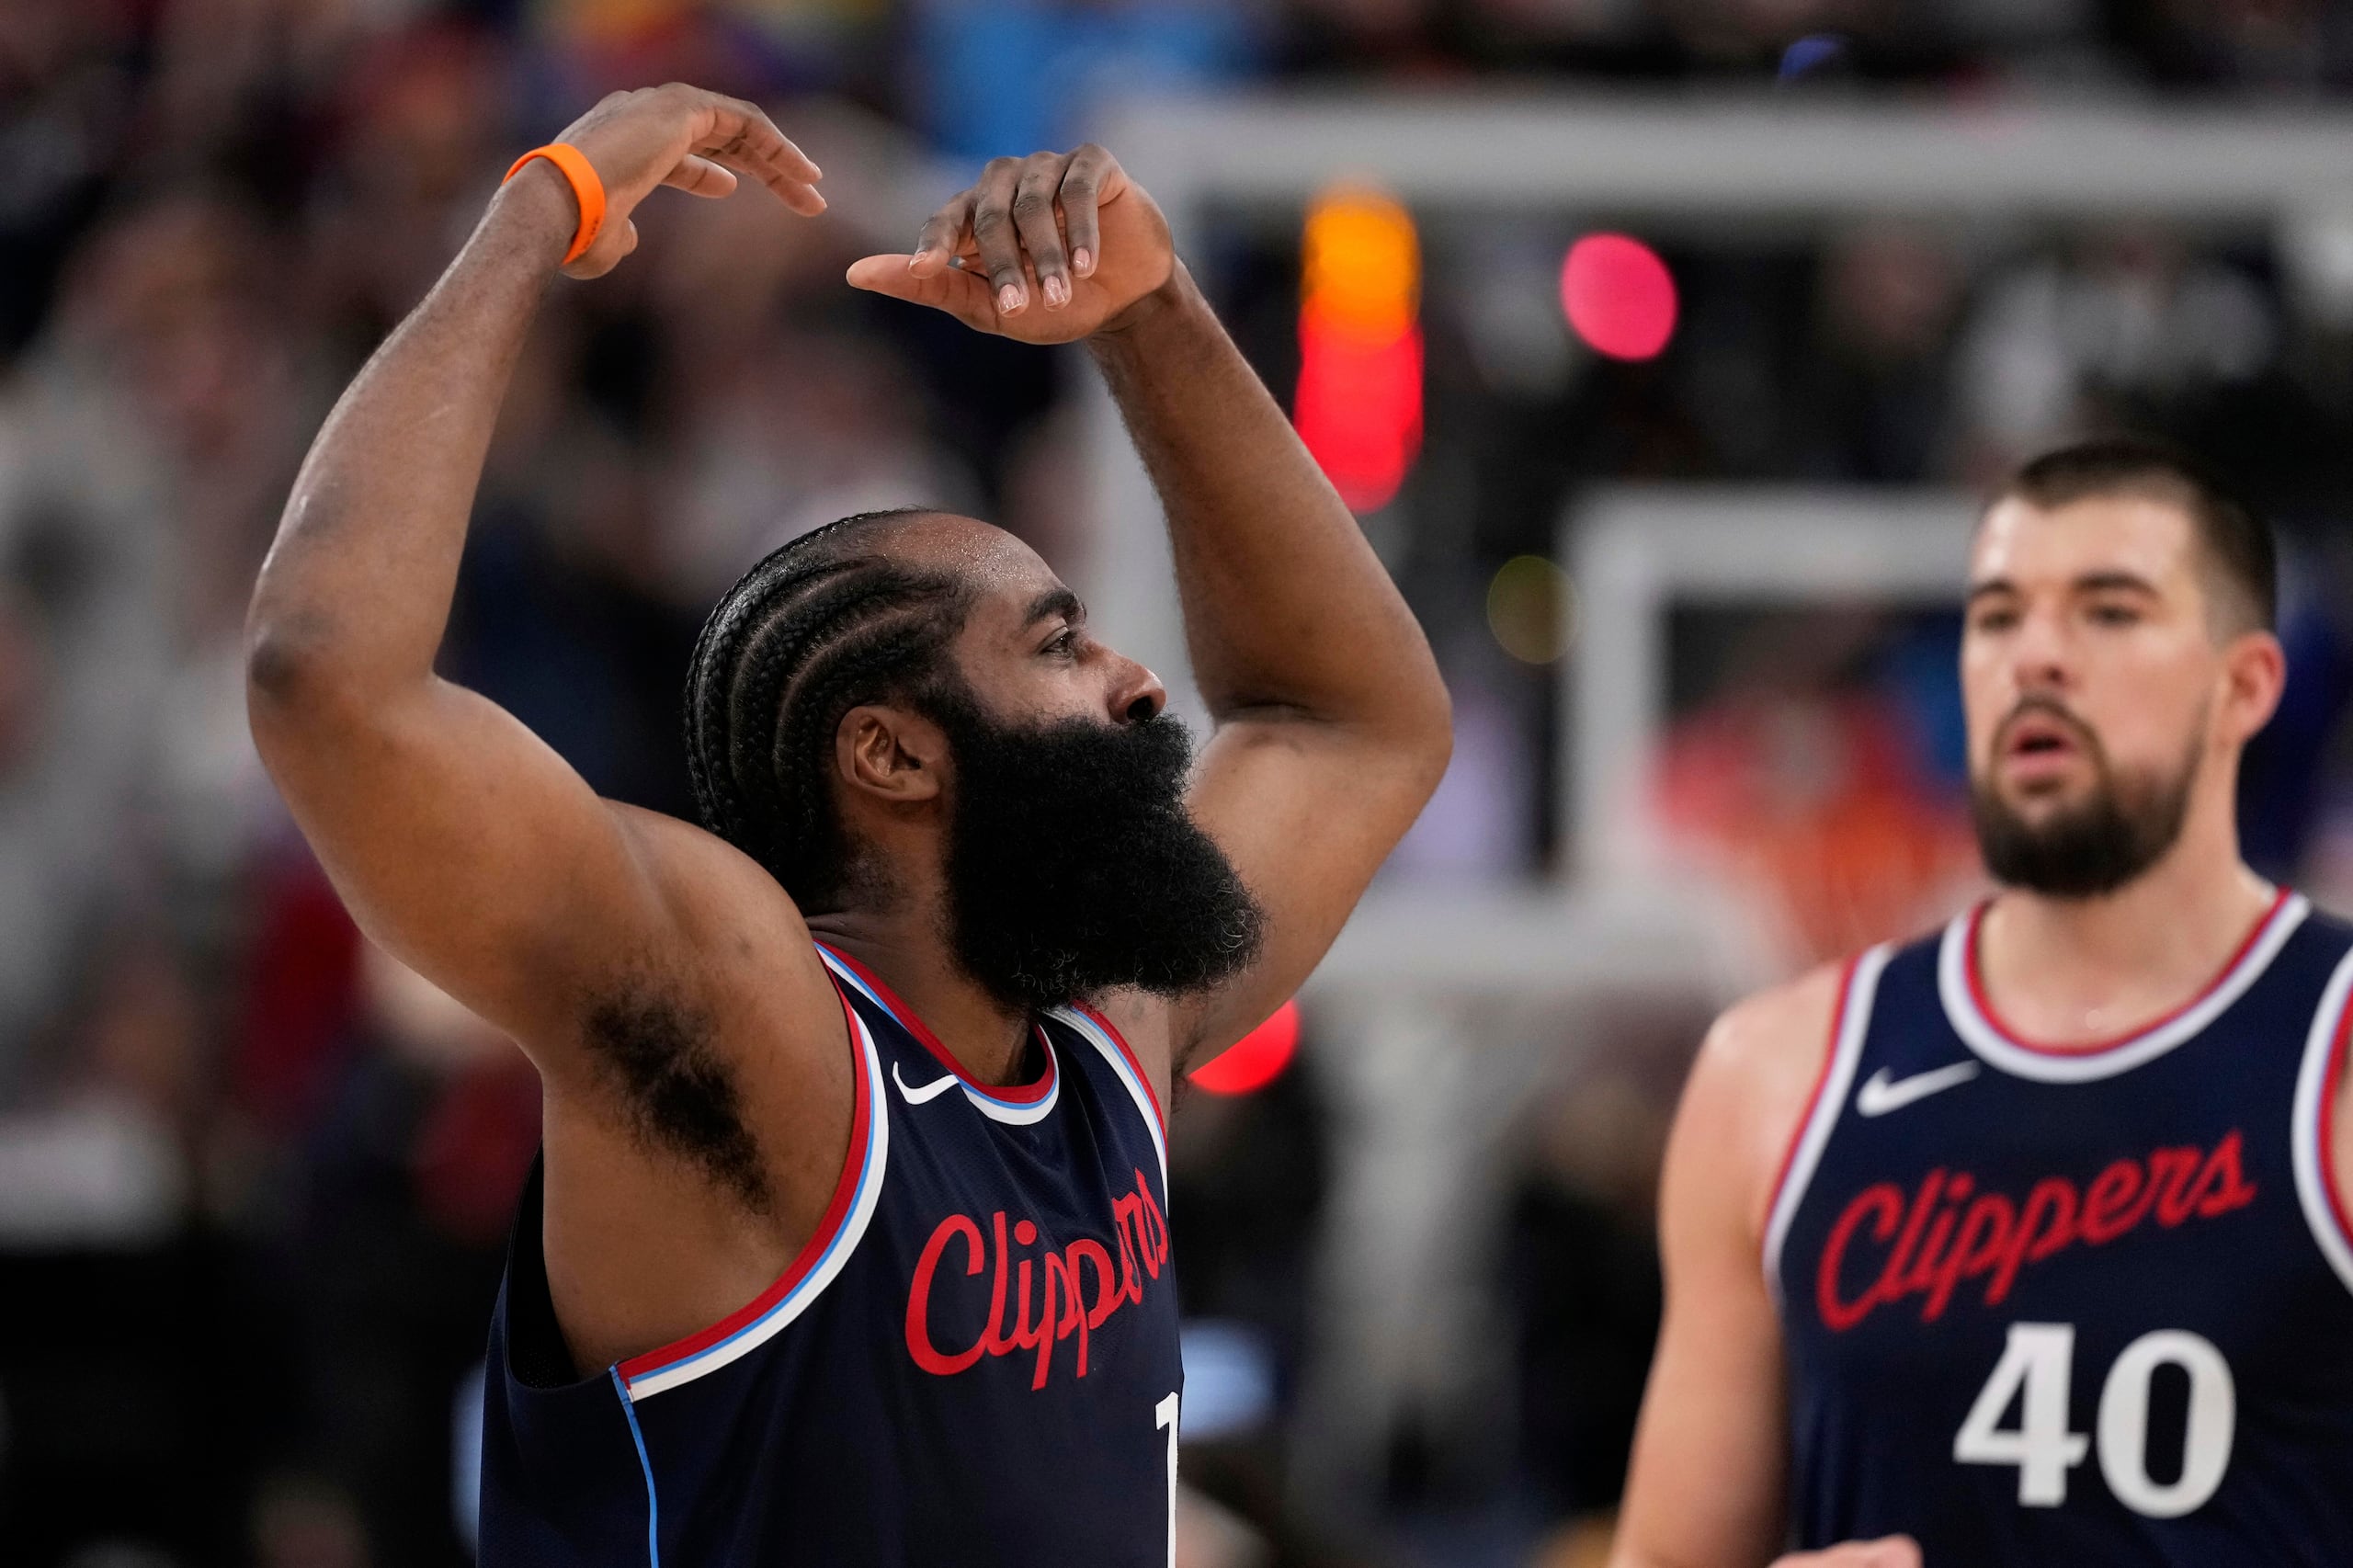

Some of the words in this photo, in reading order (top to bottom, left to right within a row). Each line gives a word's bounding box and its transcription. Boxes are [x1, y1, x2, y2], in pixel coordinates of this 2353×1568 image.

[904, 1167, 1169, 1392] Clippers
[1816, 1131, 2257, 1331] Clippers
[1953, 1322, 2236, 1518] 40
